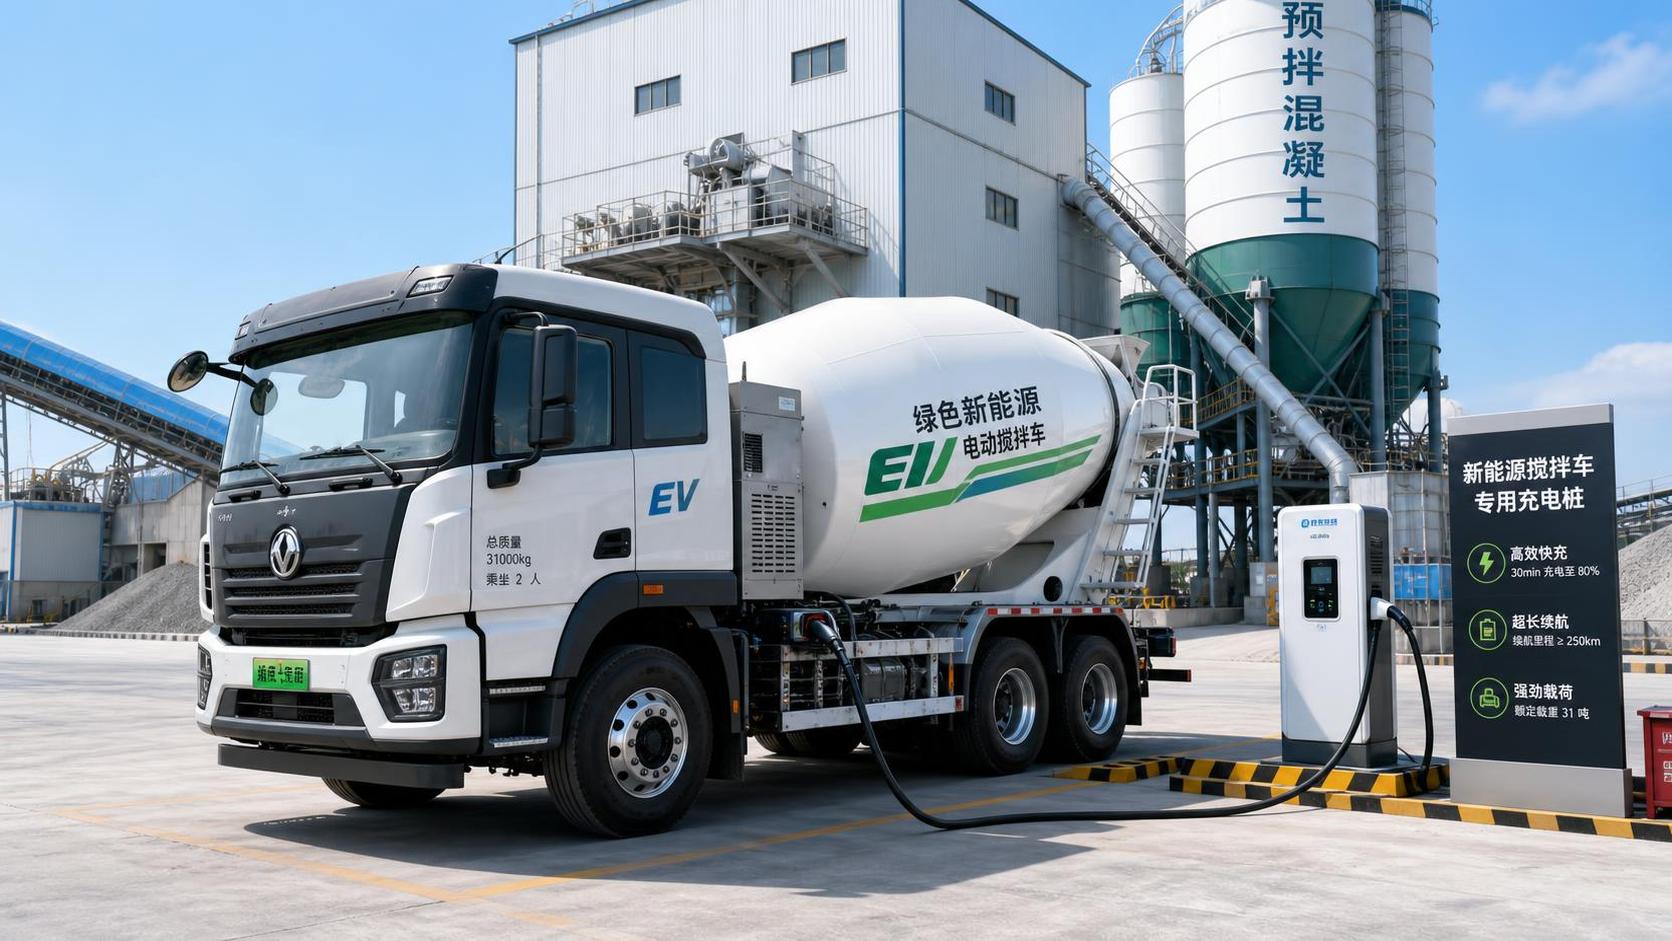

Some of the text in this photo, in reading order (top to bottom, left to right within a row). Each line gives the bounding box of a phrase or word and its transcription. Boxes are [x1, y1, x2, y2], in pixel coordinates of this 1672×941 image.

[1281, 1, 1325, 223] 预拌混凝土
[912, 385, 1042, 434] 绿色新能源
[963, 422, 1046, 460] 电动搅拌车
[1463, 453, 1595, 484] 新能源搅拌车
[648, 478, 700, 516] EV
[1474, 485, 1585, 514] 专用充电桩
[486, 535, 522, 550] 总质量
[486, 553, 532, 567] 31000kg
[1510, 544, 1568, 562] 高效快充
[515, 574, 522, 585] 2
[530, 572, 541, 585] 人
[1510, 565, 1600, 578] 30min 充电至 80%
[1511, 613, 1569, 630] 超长续航
[1566, 635, 1601, 647] 250km
[1513, 682, 1573, 701] 强劲载荷
[1562, 707, 1574, 719] 31
